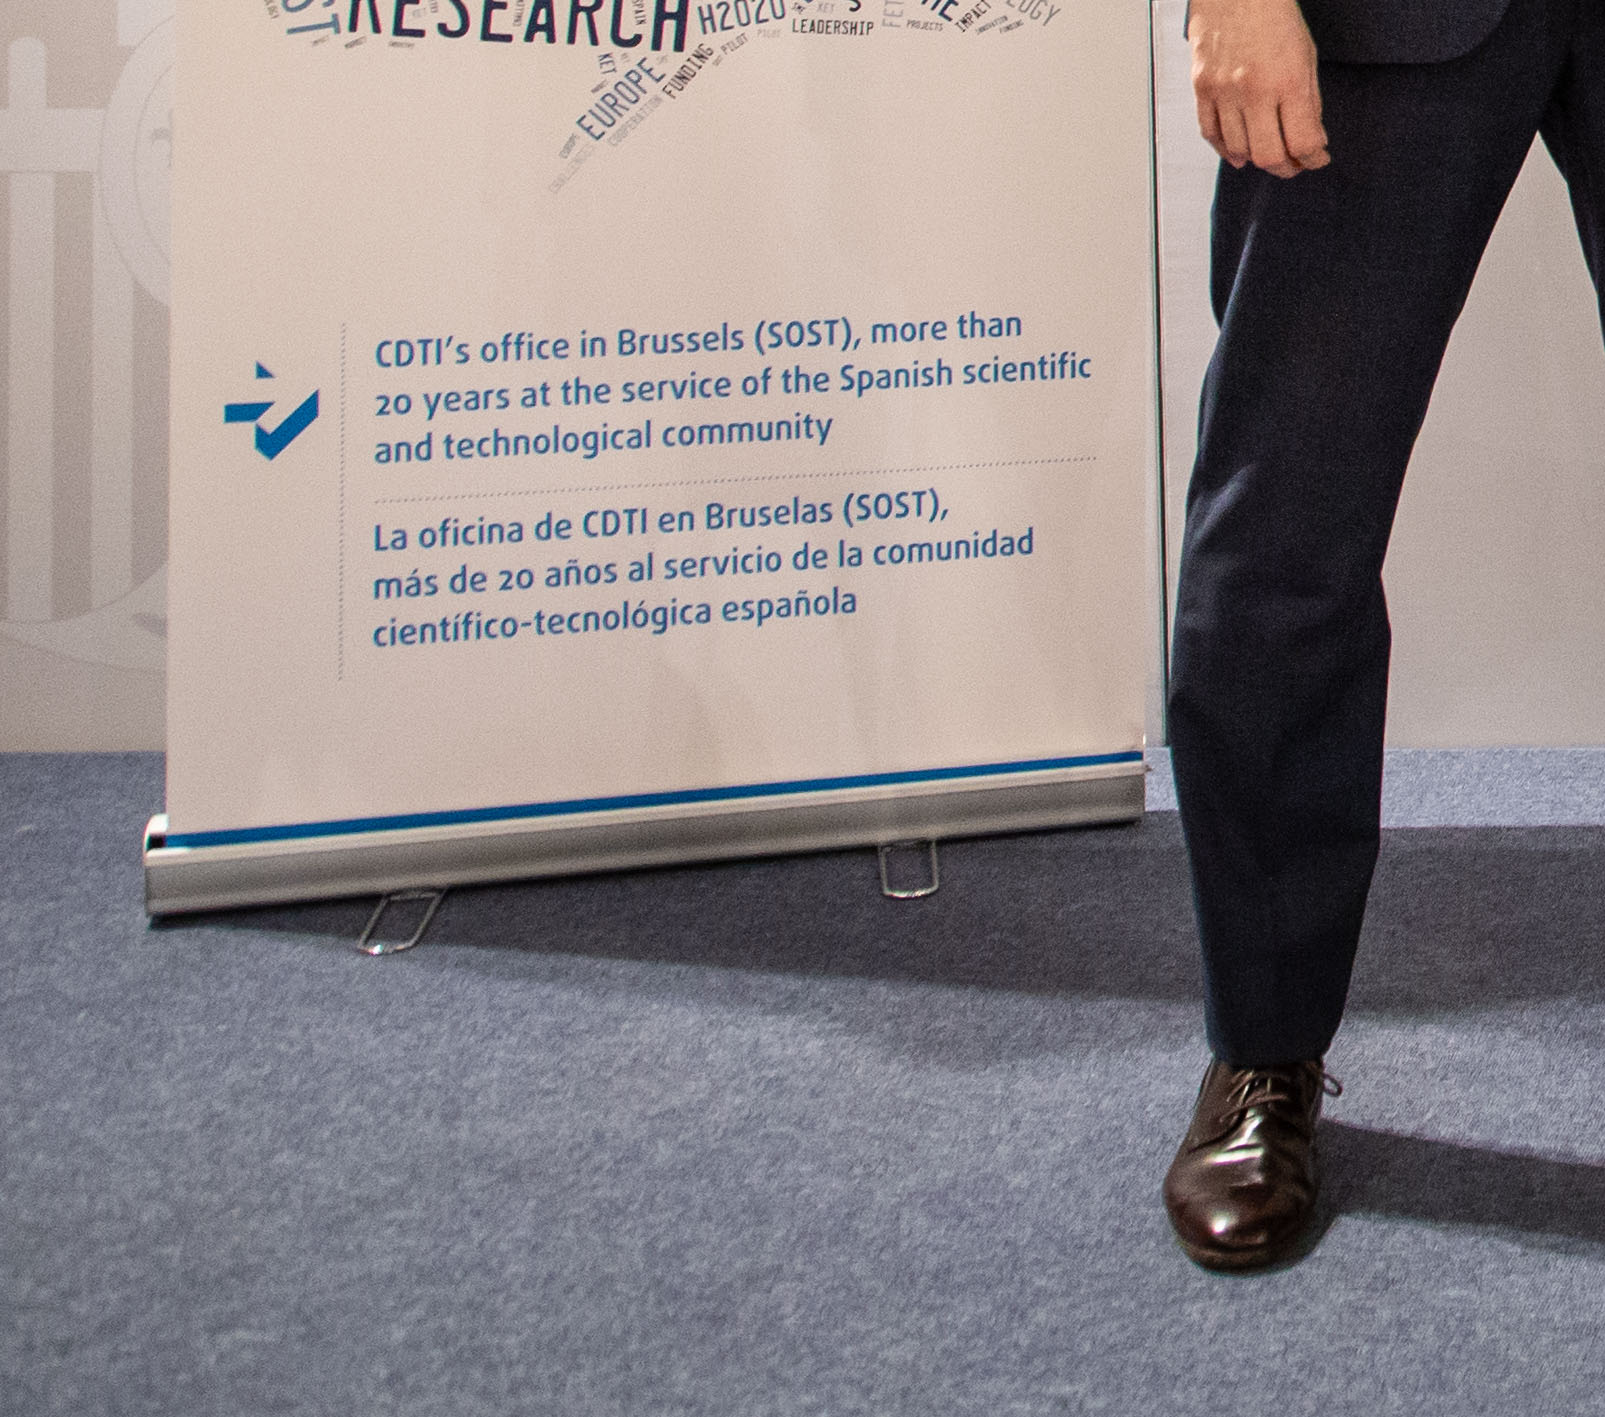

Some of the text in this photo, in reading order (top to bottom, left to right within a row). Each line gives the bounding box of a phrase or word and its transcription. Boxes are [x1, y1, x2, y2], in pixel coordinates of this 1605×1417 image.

[375, 311, 1021, 368] CDTI's office in Brussels (SOST), more than
[376, 351, 1091, 421] 20 years at the service of the Spanish scientific
[374, 415, 833, 464] and technological community
[374, 488, 948, 551] La oficina de CDTI en Bruselas (SOST),
[373, 526, 1033, 599] más de 20 años al servicio de la comunidad
[372, 586, 856, 647] científico-tecnológica española
